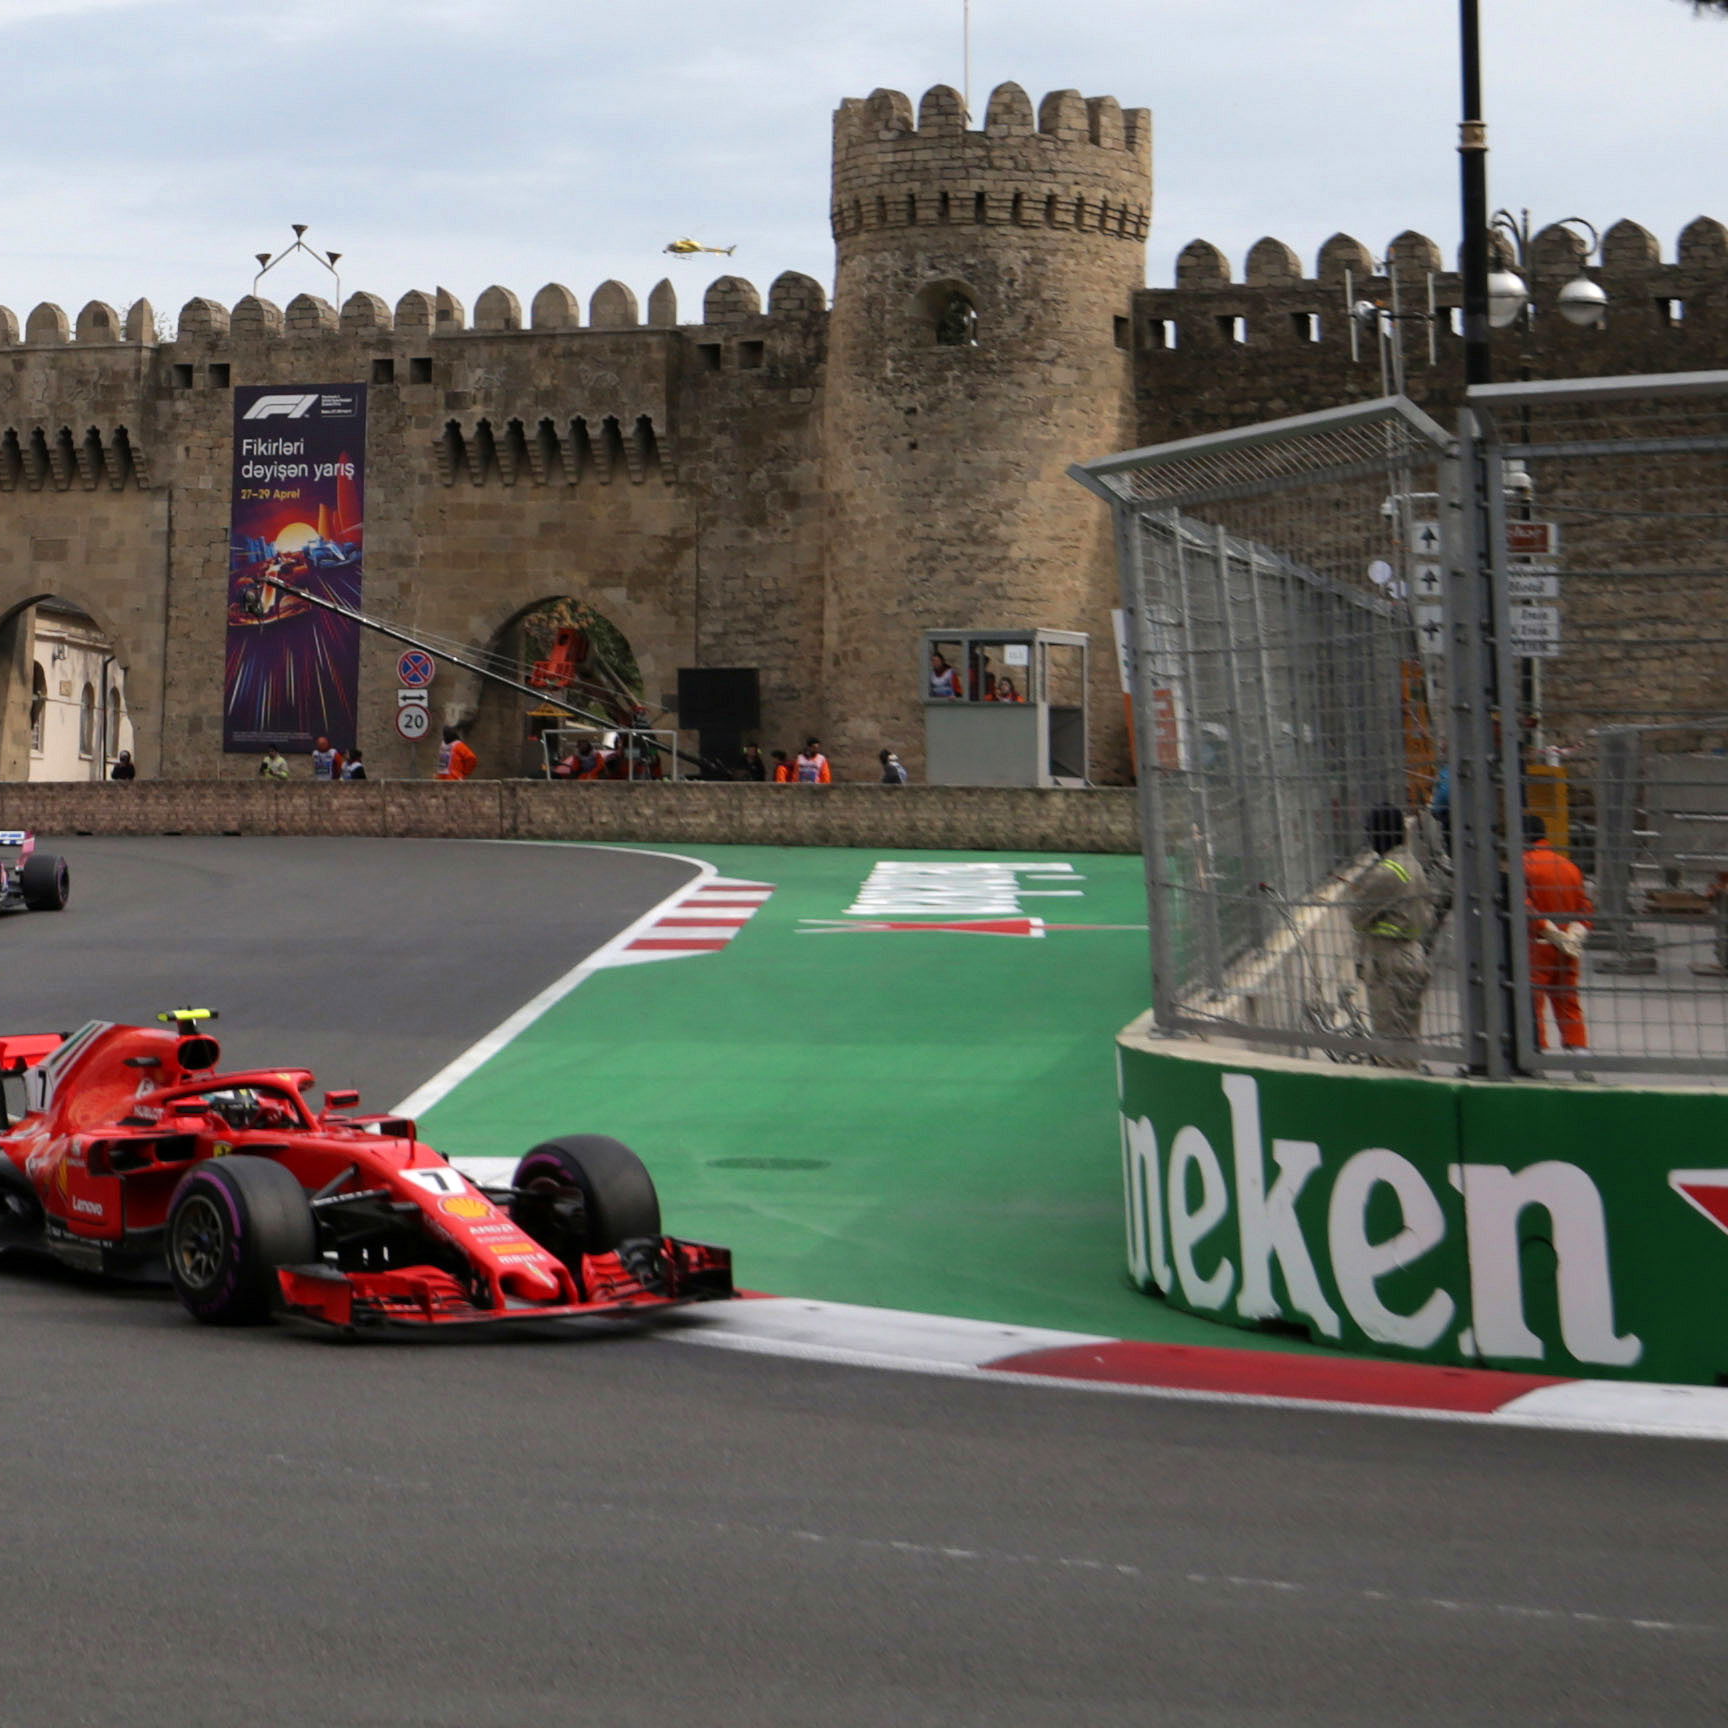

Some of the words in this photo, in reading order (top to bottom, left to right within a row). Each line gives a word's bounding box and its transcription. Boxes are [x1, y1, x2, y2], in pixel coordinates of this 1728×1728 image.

[242, 437, 304, 456] Fikirləri
[241, 460, 308, 482] dəyişən
[313, 462, 355, 481] yarış
[273, 488, 300, 500] Aprel
[404, 714, 424, 729] 20
[418, 1170, 450, 1192] 7
[71, 1194, 104, 1217] Lenovo
